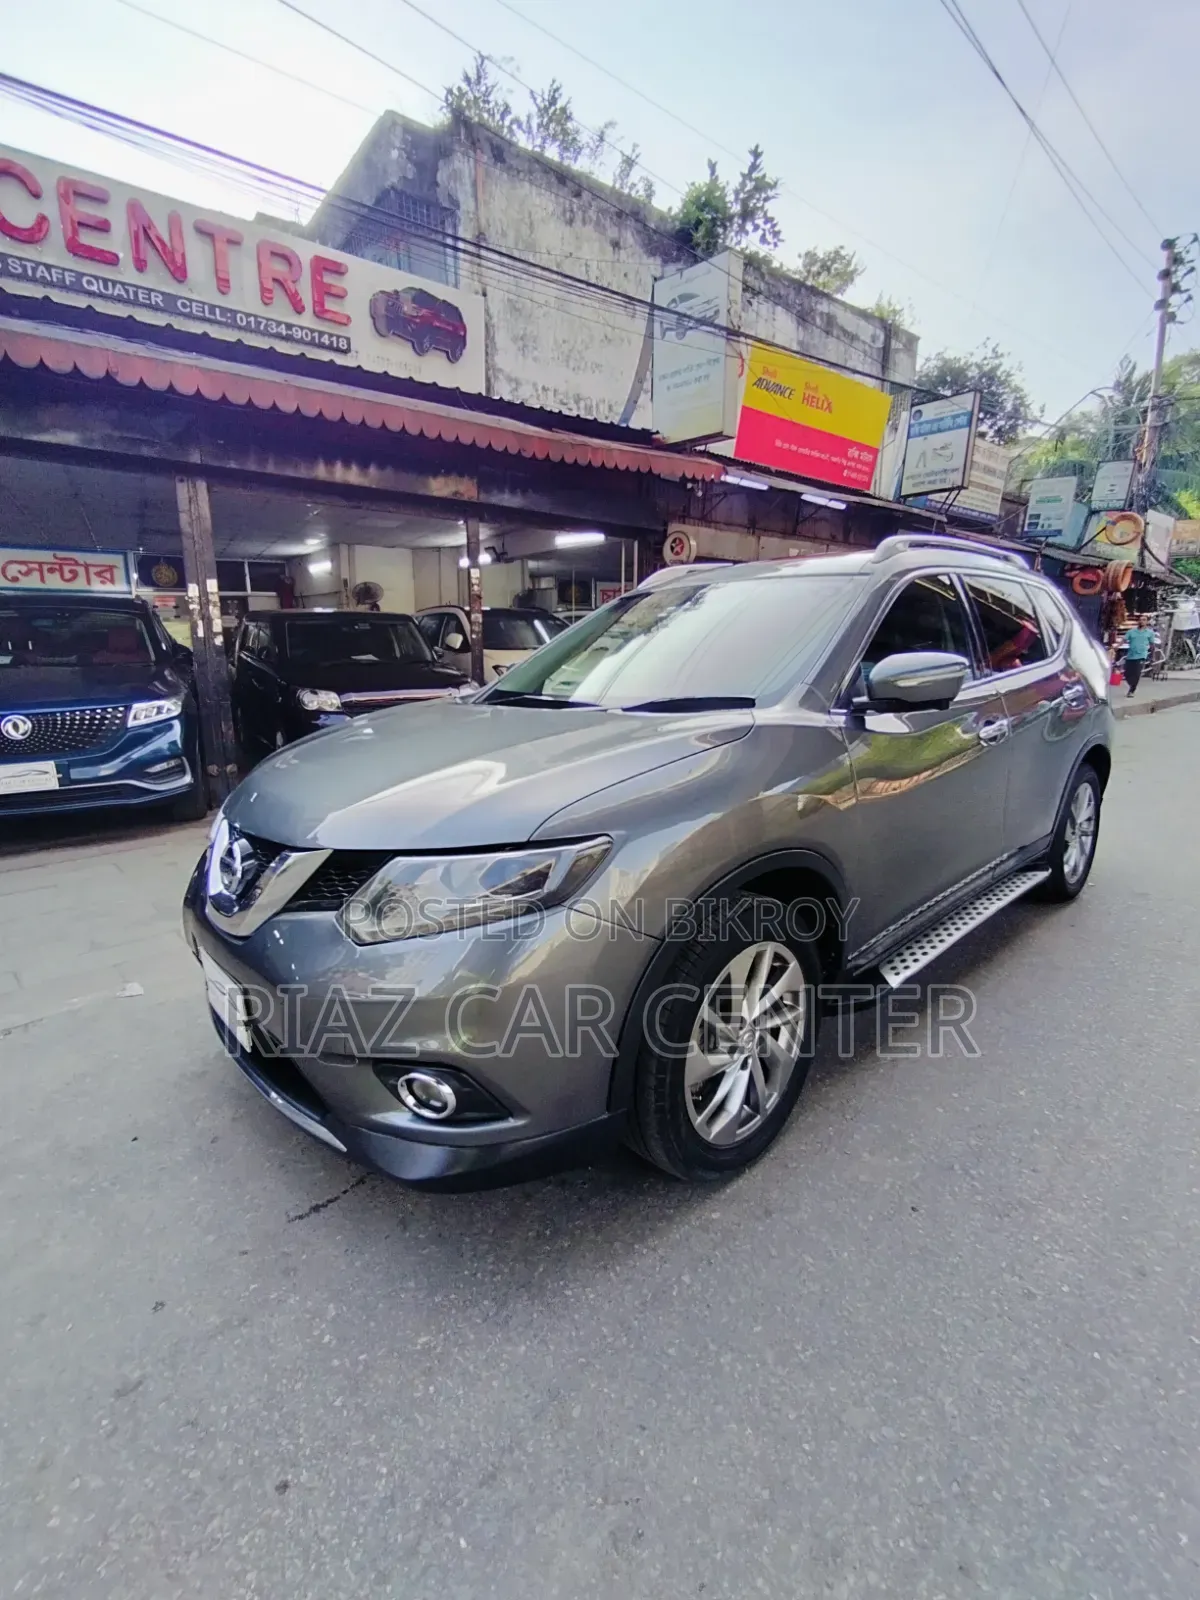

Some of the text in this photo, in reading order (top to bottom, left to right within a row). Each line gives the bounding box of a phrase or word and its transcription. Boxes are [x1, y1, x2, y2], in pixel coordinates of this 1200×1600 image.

[0, 158, 352, 326] CENTRE
[8, 258, 348, 350] STAFF QUATER CELL: 01734-901418
[752, 377, 796, 400] ADVANCE
[802, 392, 833, 414] HELIX
[1, 553, 117, 586] সেন্টার
